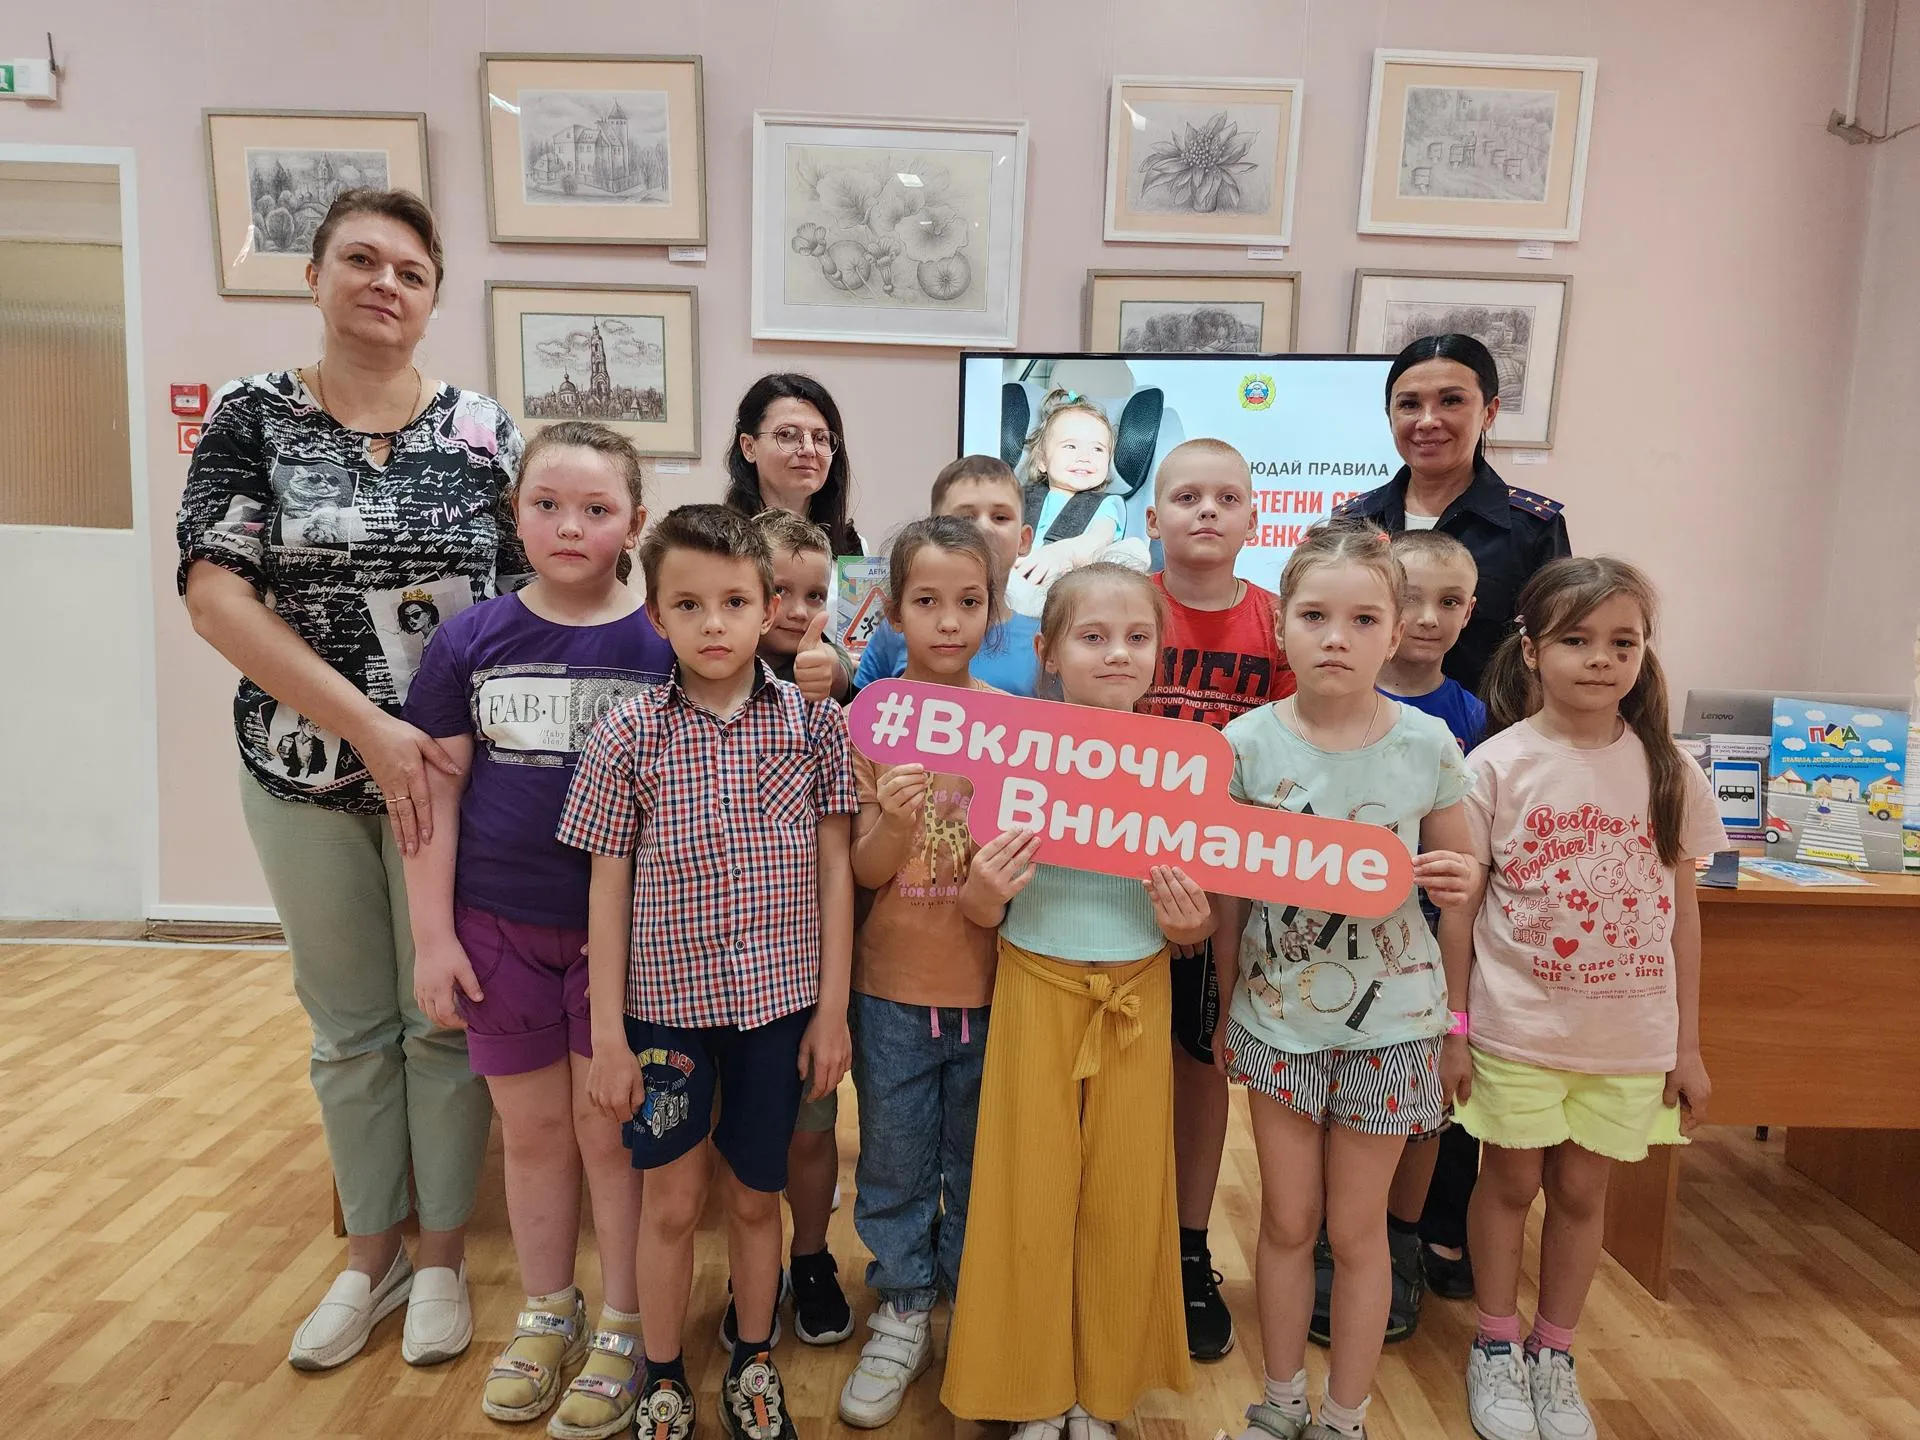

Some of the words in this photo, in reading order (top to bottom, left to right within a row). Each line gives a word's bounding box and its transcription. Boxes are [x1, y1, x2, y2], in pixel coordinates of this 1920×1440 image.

[1250, 461, 1301, 476] ЮДАЙ
[1308, 462, 1389, 476] ПРАВИЛА
[1186, 689, 1203, 698] AND
[1204, 690, 1241, 701] PEOPLES
[1184, 698, 1201, 709] AND
[1202, 701, 1238, 713] PEOPLES
[1701, 711, 1735, 720] Lenovo
[870, 691, 1209, 797] #Включи
[1526, 804, 1630, 839] Besties
[997, 776, 1389, 892] Внимание
[1502, 829, 1598, 892] Together!
[900, 886, 926, 898] FOR
[928, 886, 959, 897] SUM
[1513, 911, 1554, 931] そして
[1532, 955, 1572, 972] take
[1578, 959, 1615, 972] care
[1639, 954, 1665, 966] you
[1532, 968, 1562, 982] self
[1583, 972, 1616, 984] love
[1635, 966, 1665, 978] first
